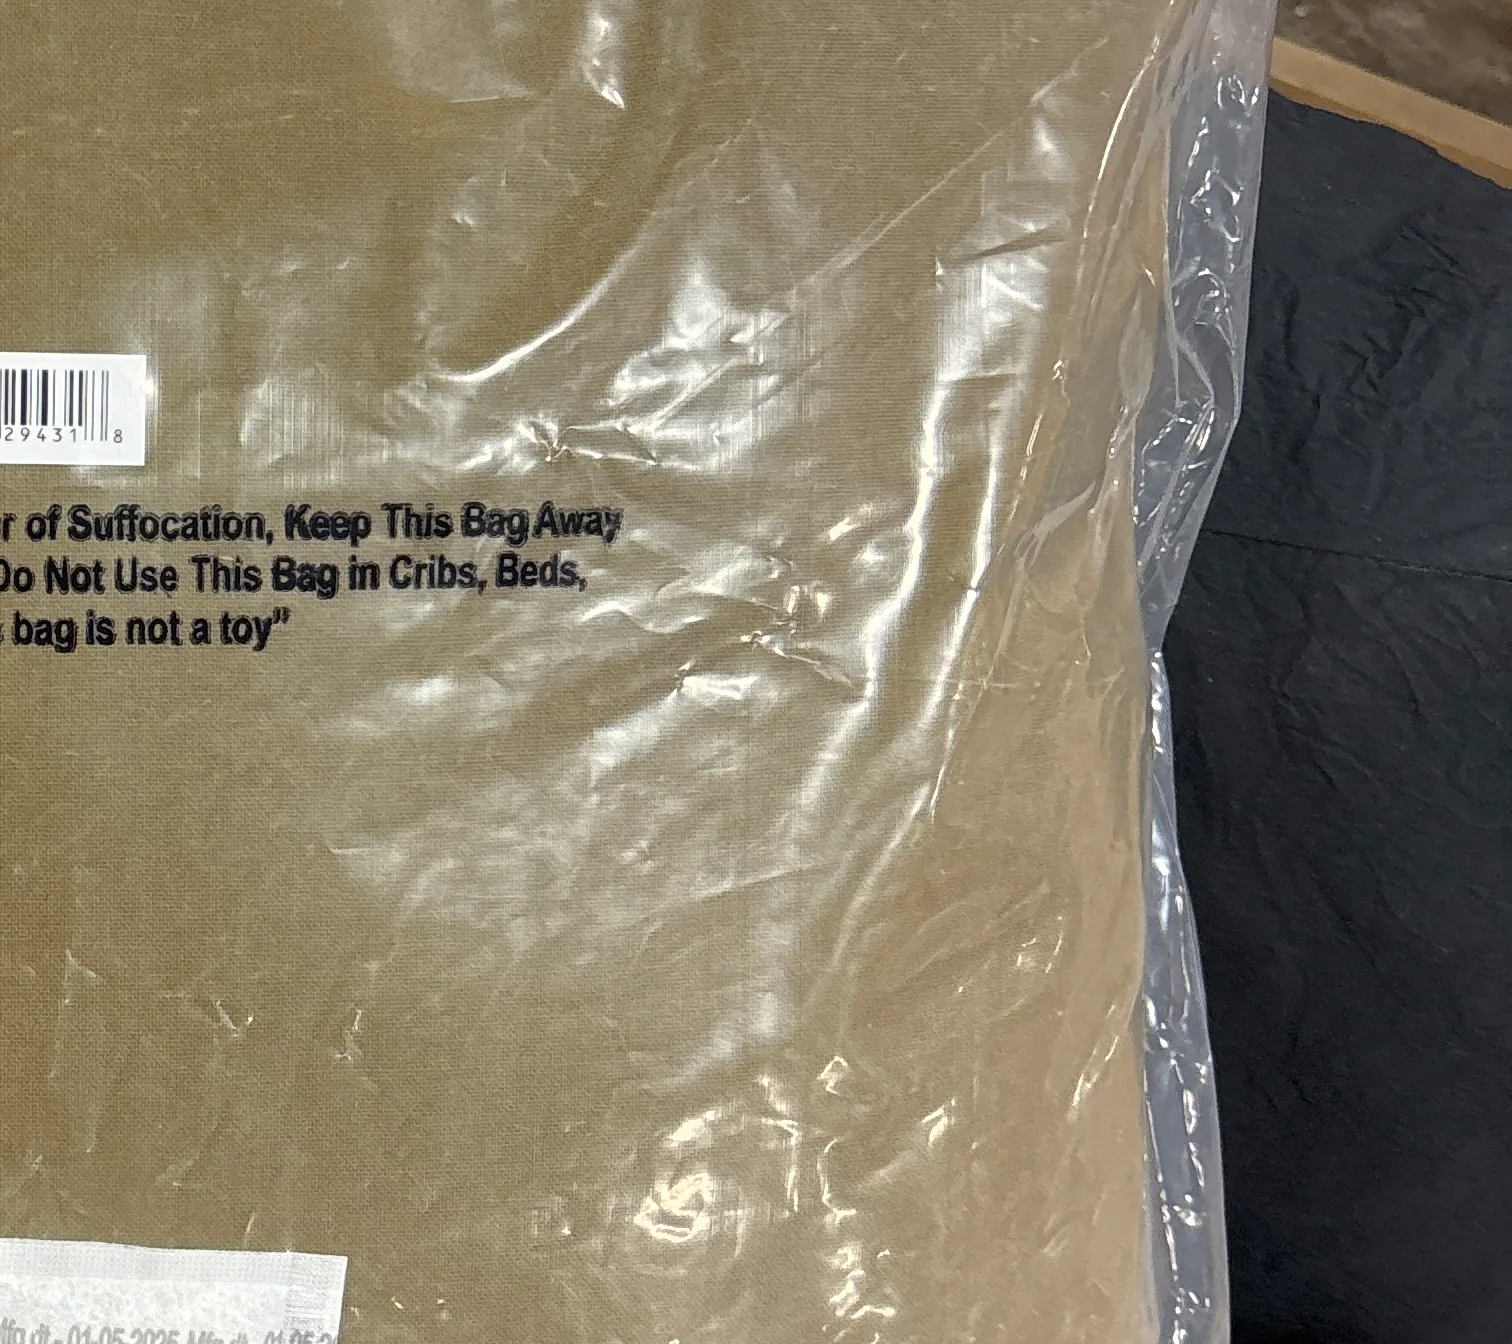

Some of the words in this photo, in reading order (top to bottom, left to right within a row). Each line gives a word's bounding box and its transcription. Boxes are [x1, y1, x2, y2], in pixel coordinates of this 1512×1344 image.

[4, 426, 78, 443] 29431
[26, 503, 62, 541] of
[68, 503, 275, 545] Suffocation,
[285, 503, 372, 547] Keep
[382, 503, 454, 540] This
[461, 502, 528, 546] Bag
[533, 501, 624, 544] Away
[45, 555, 104, 594] Not
[114, 556, 179, 594] Use
[192, 555, 263, 593] This
[272, 555, 339, 599] Bag
[348, 555, 380, 591] in
[388, 554, 488, 596] Cribs,
[495, 552, 588, 593] Beds,
[13, 611, 77, 653] bag
[87, 610, 116, 646] is
[126, 612, 183, 646] not
[190, 617, 212, 646] a
